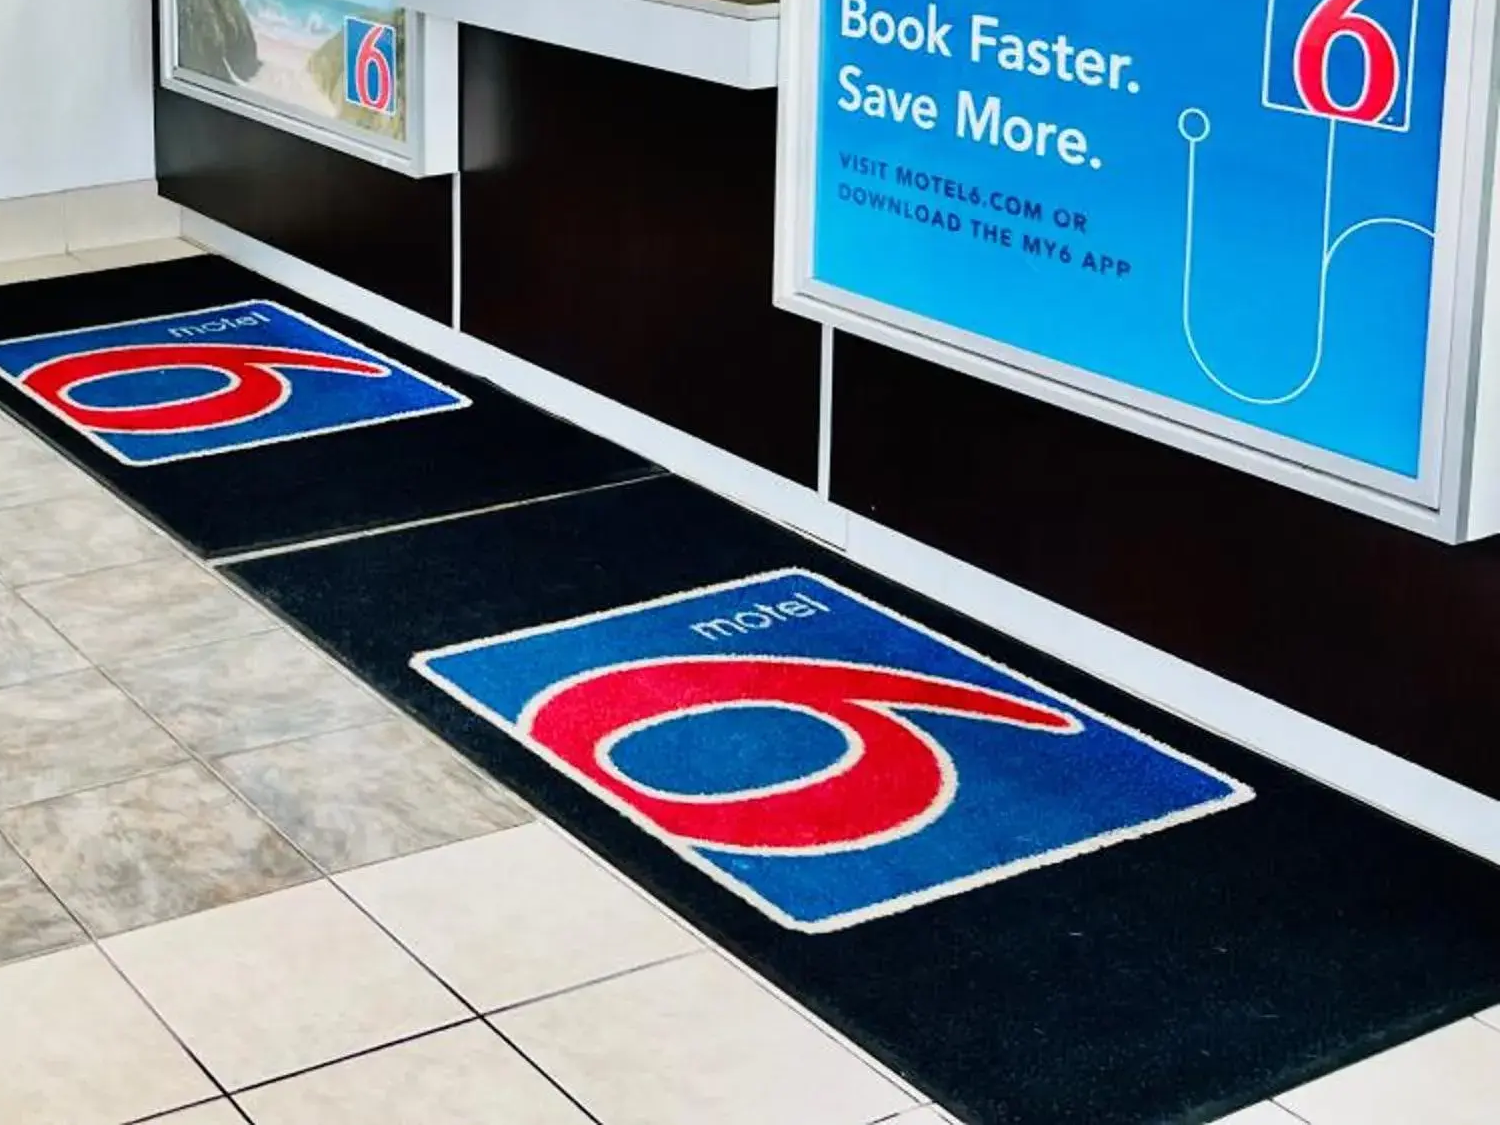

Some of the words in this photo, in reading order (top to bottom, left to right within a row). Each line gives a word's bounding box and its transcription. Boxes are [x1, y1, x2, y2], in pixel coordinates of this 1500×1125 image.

[355, 23, 392, 113] 6
[970, 14, 1141, 94] Faster.
[837, 64, 938, 130] Save
[956, 90, 1103, 170] More.
[838, 182, 962, 233] DOWNLOAD
[970, 218, 1013, 247] THE
[1022, 234, 1072, 264] MY6
[1081, 251, 1132, 277] APP
[839, 151, 889, 180] VISIT
[895, 165, 1042, 221] MOTEL6.COM
[1053, 208, 1087, 234] OR
[167, 310, 271, 337] motel
[17, 342, 393, 434] 6
[689, 591, 831, 641] motel
[512, 654, 1085, 858] 6
